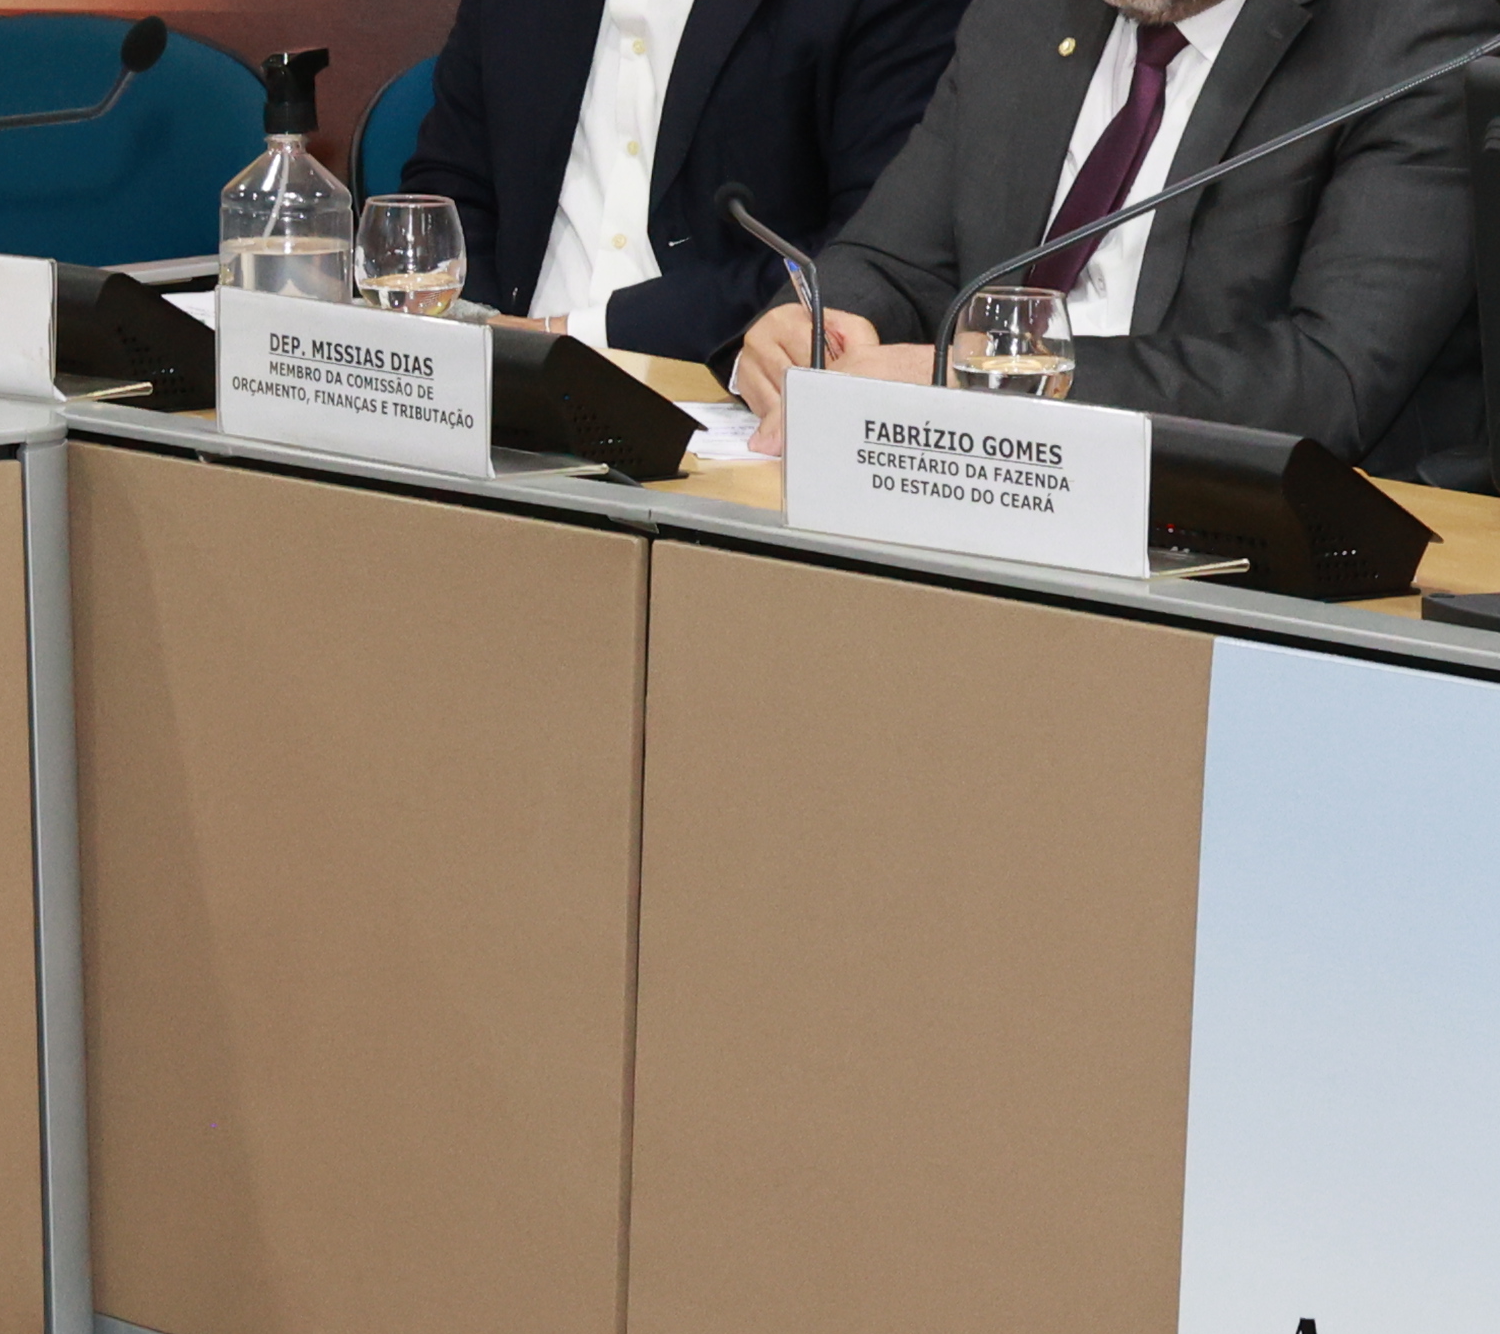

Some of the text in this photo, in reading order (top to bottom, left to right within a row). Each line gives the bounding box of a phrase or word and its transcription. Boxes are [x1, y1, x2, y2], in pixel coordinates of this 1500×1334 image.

[271, 333, 433, 376] DEP. MISSIAS DIAS
[270, 362, 433, 400] MEMBRO DA COMISSÃO DE
[233, 376, 473, 429] ORÇAMENTO, FINANÇAS E TRIBUTAÇÃO
[865, 420, 1062, 465] FABRÍZIO GOMES
[857, 449, 1070, 491] SECRETÁRIO DA FAZENDA
[873, 474, 1054, 512] DO ESTADO DO CEARÁ
